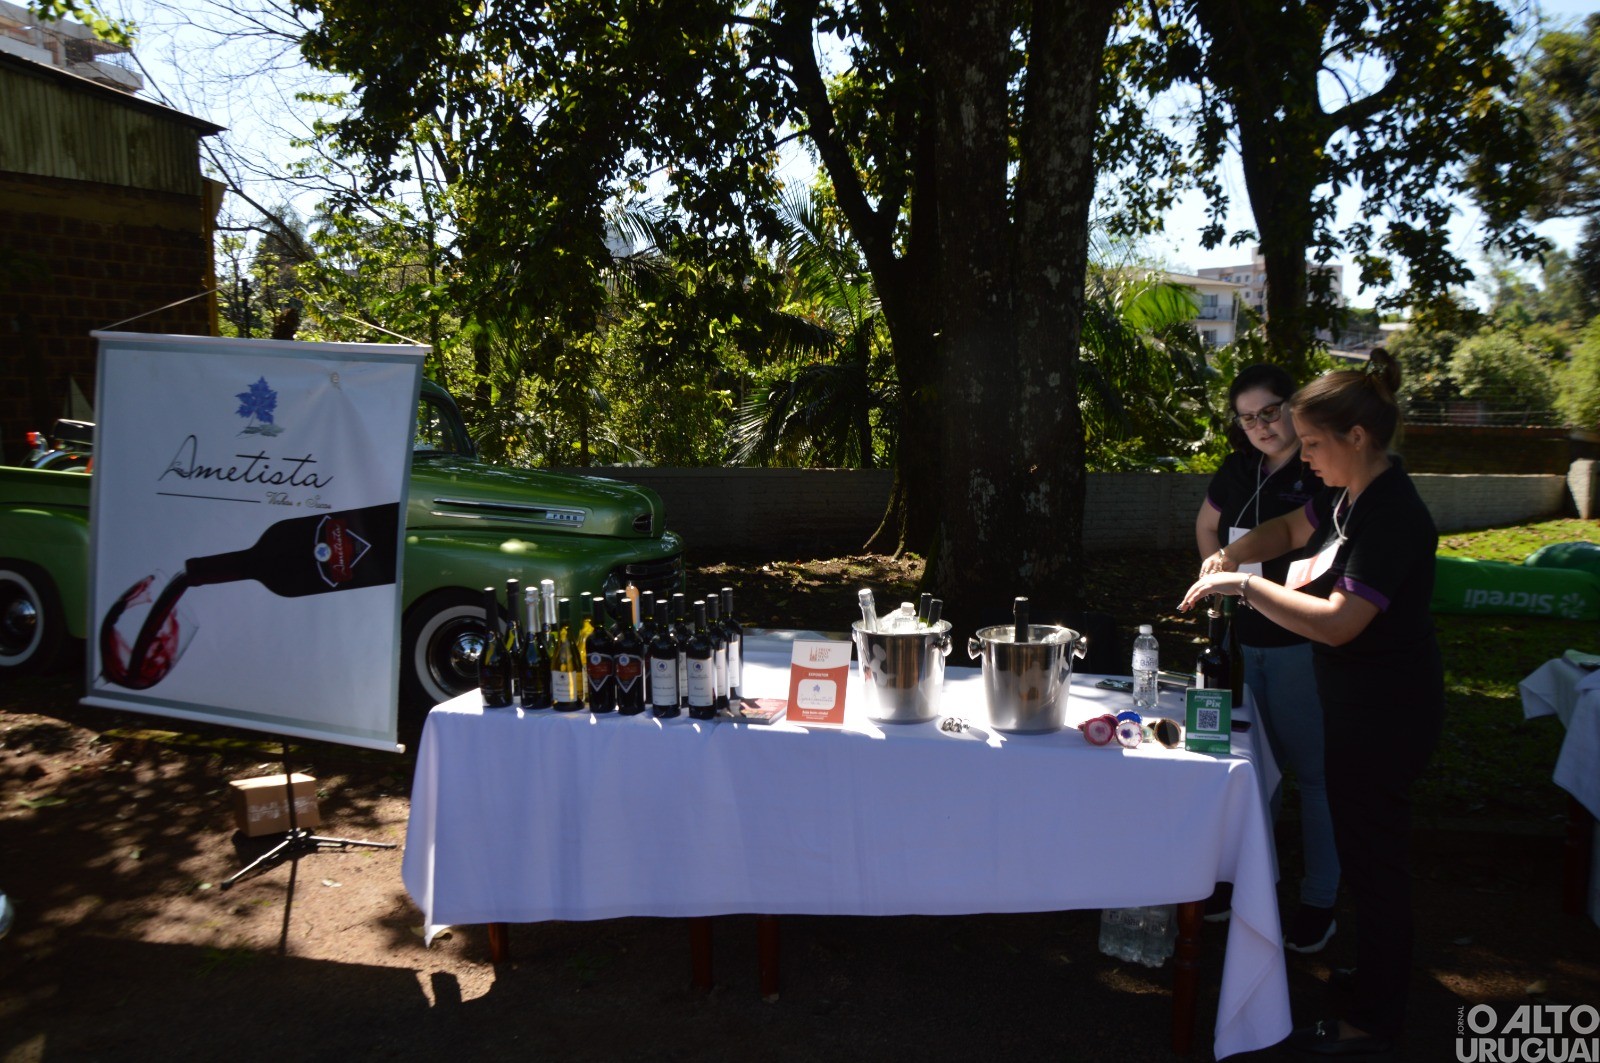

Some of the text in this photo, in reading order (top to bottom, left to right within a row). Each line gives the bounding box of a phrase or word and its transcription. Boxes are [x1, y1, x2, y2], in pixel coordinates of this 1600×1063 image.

[157, 434, 334, 488] Ametista
[1463, 588, 1555, 614] Sicredi
[1205, 699, 1222, 708] Pix
